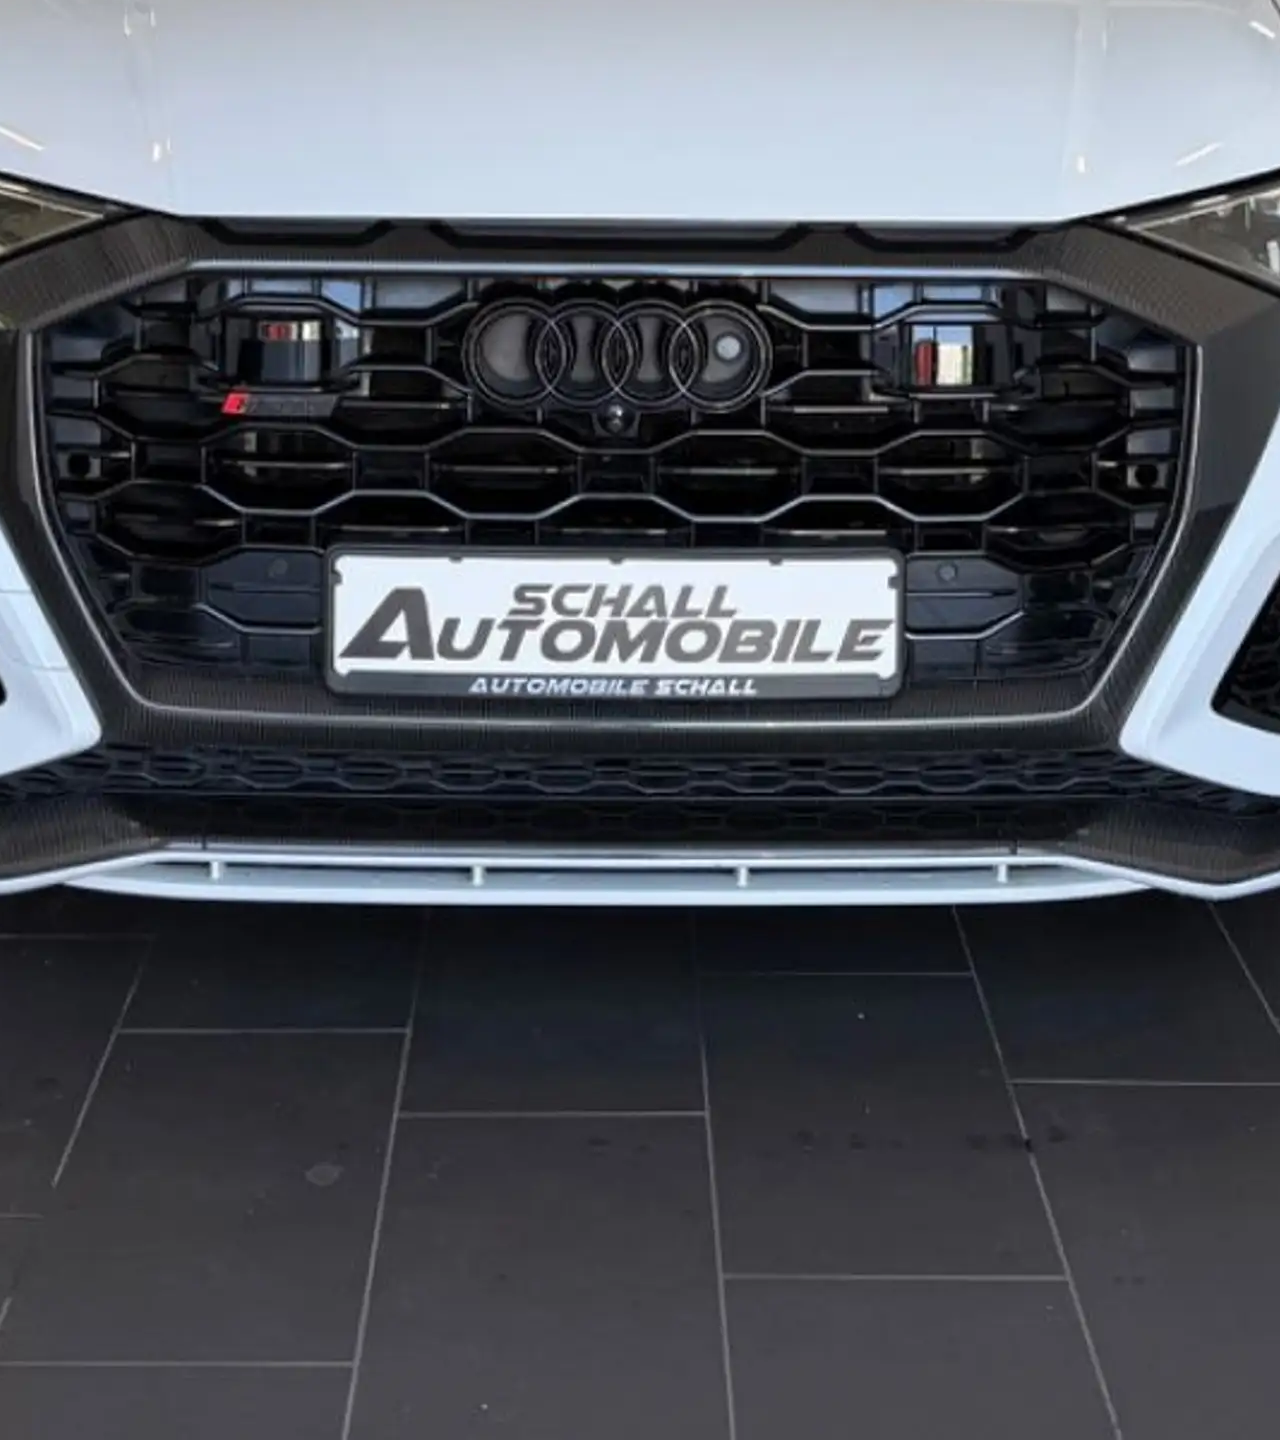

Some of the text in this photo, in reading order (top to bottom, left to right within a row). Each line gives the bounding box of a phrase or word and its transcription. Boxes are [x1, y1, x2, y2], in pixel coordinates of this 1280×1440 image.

[508, 583, 738, 619] SCHALL
[339, 587, 894, 664] AUTOMOBILE
[468, 676, 758, 696] AUTOMOBILE SCHALL
